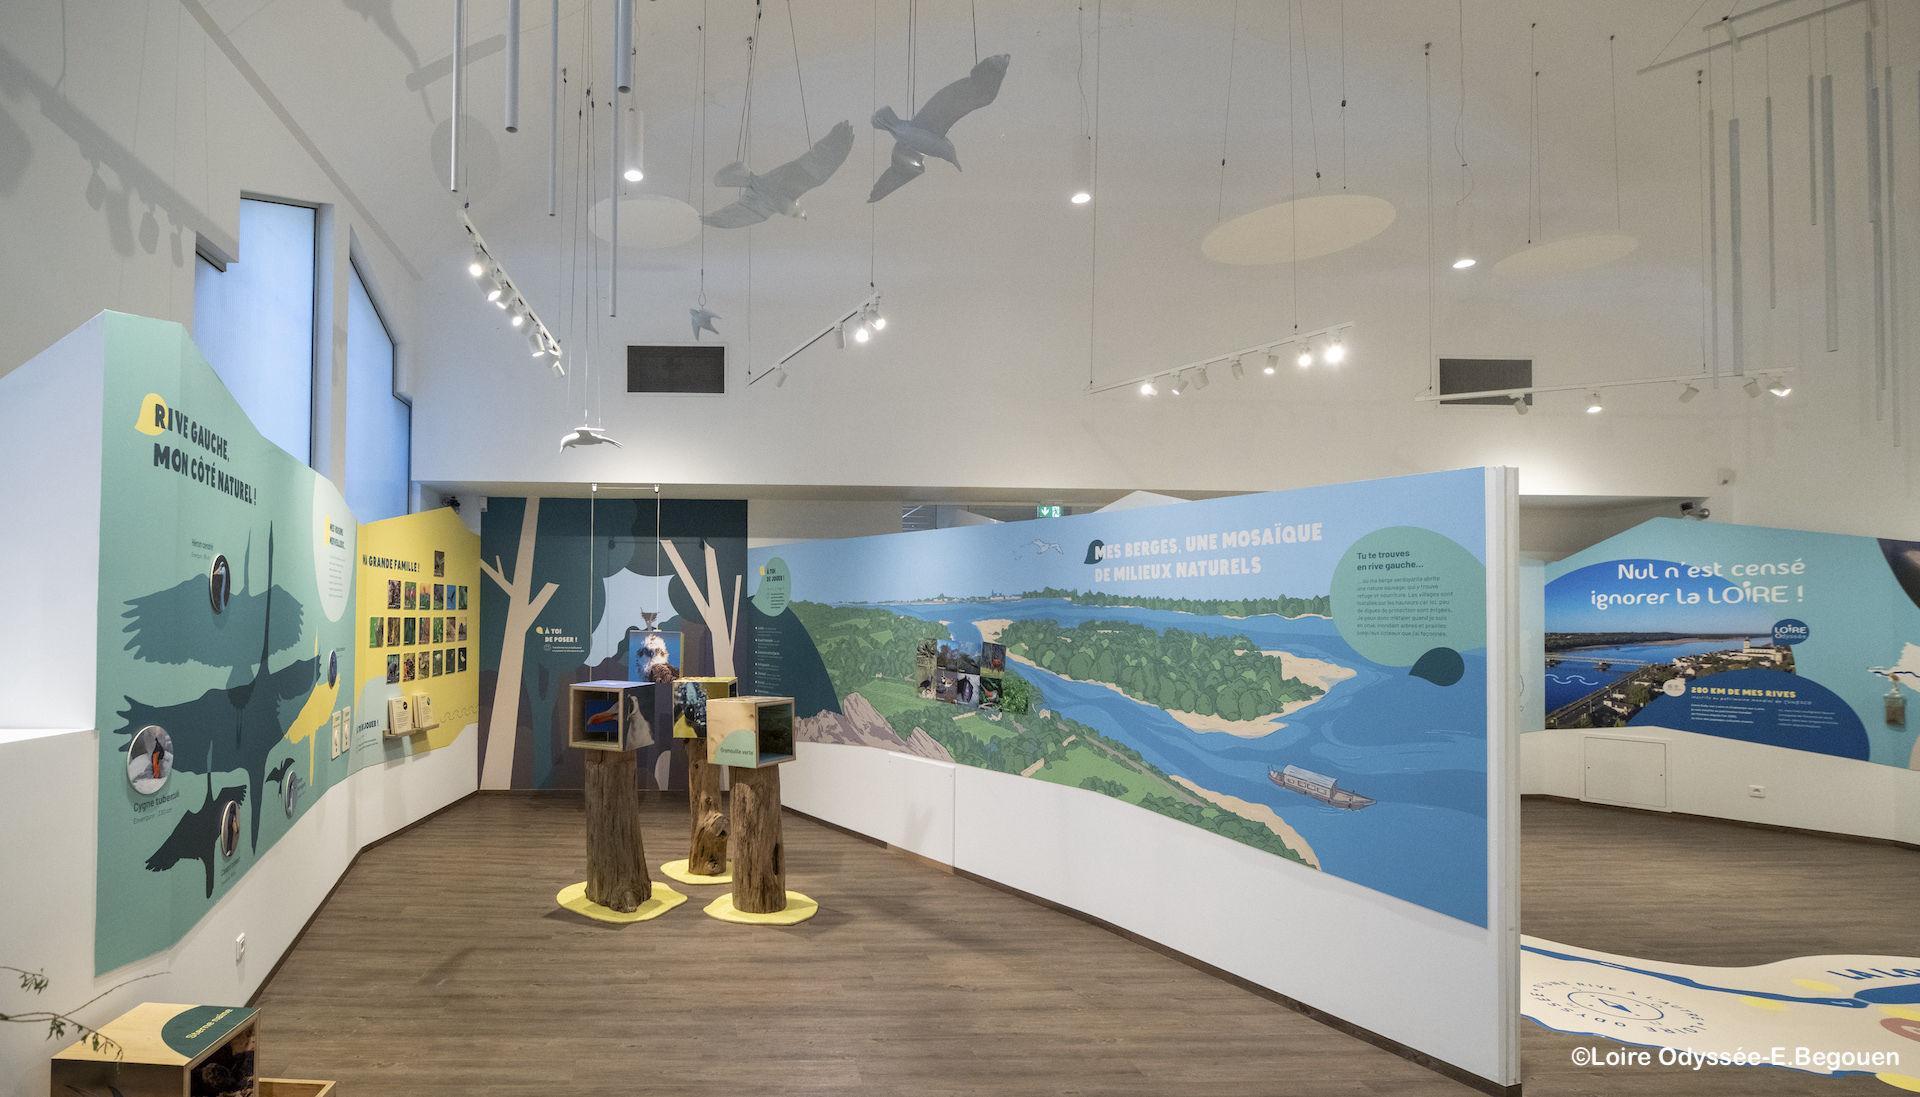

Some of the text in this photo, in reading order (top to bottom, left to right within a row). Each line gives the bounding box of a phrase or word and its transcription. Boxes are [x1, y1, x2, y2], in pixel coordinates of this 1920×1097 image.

[155, 403, 230, 463] RIVE GAUCHE,
[154, 442, 188, 477] MON
[190, 456, 216, 488] CÔTÉ
[218, 470, 252, 504] NATUREL
[1094, 522, 1322, 560] MES BERGES, UNE MOSAÏQUE
[369, 556, 393, 569] GRANDE
[1094, 556, 1262, 582] DE MILIEUX NATURELS
[1618, 558, 1805, 580] Nul n'est censé
[1591, 590, 1670, 610] ignorer
[1677, 588, 1700, 604] la
[1797, 585, 1803, 602] !
[133, 800, 154, 813] Cygne
[1826, 968, 1920, 980] LA LO
[186, 1021, 215, 1039] Sterne
